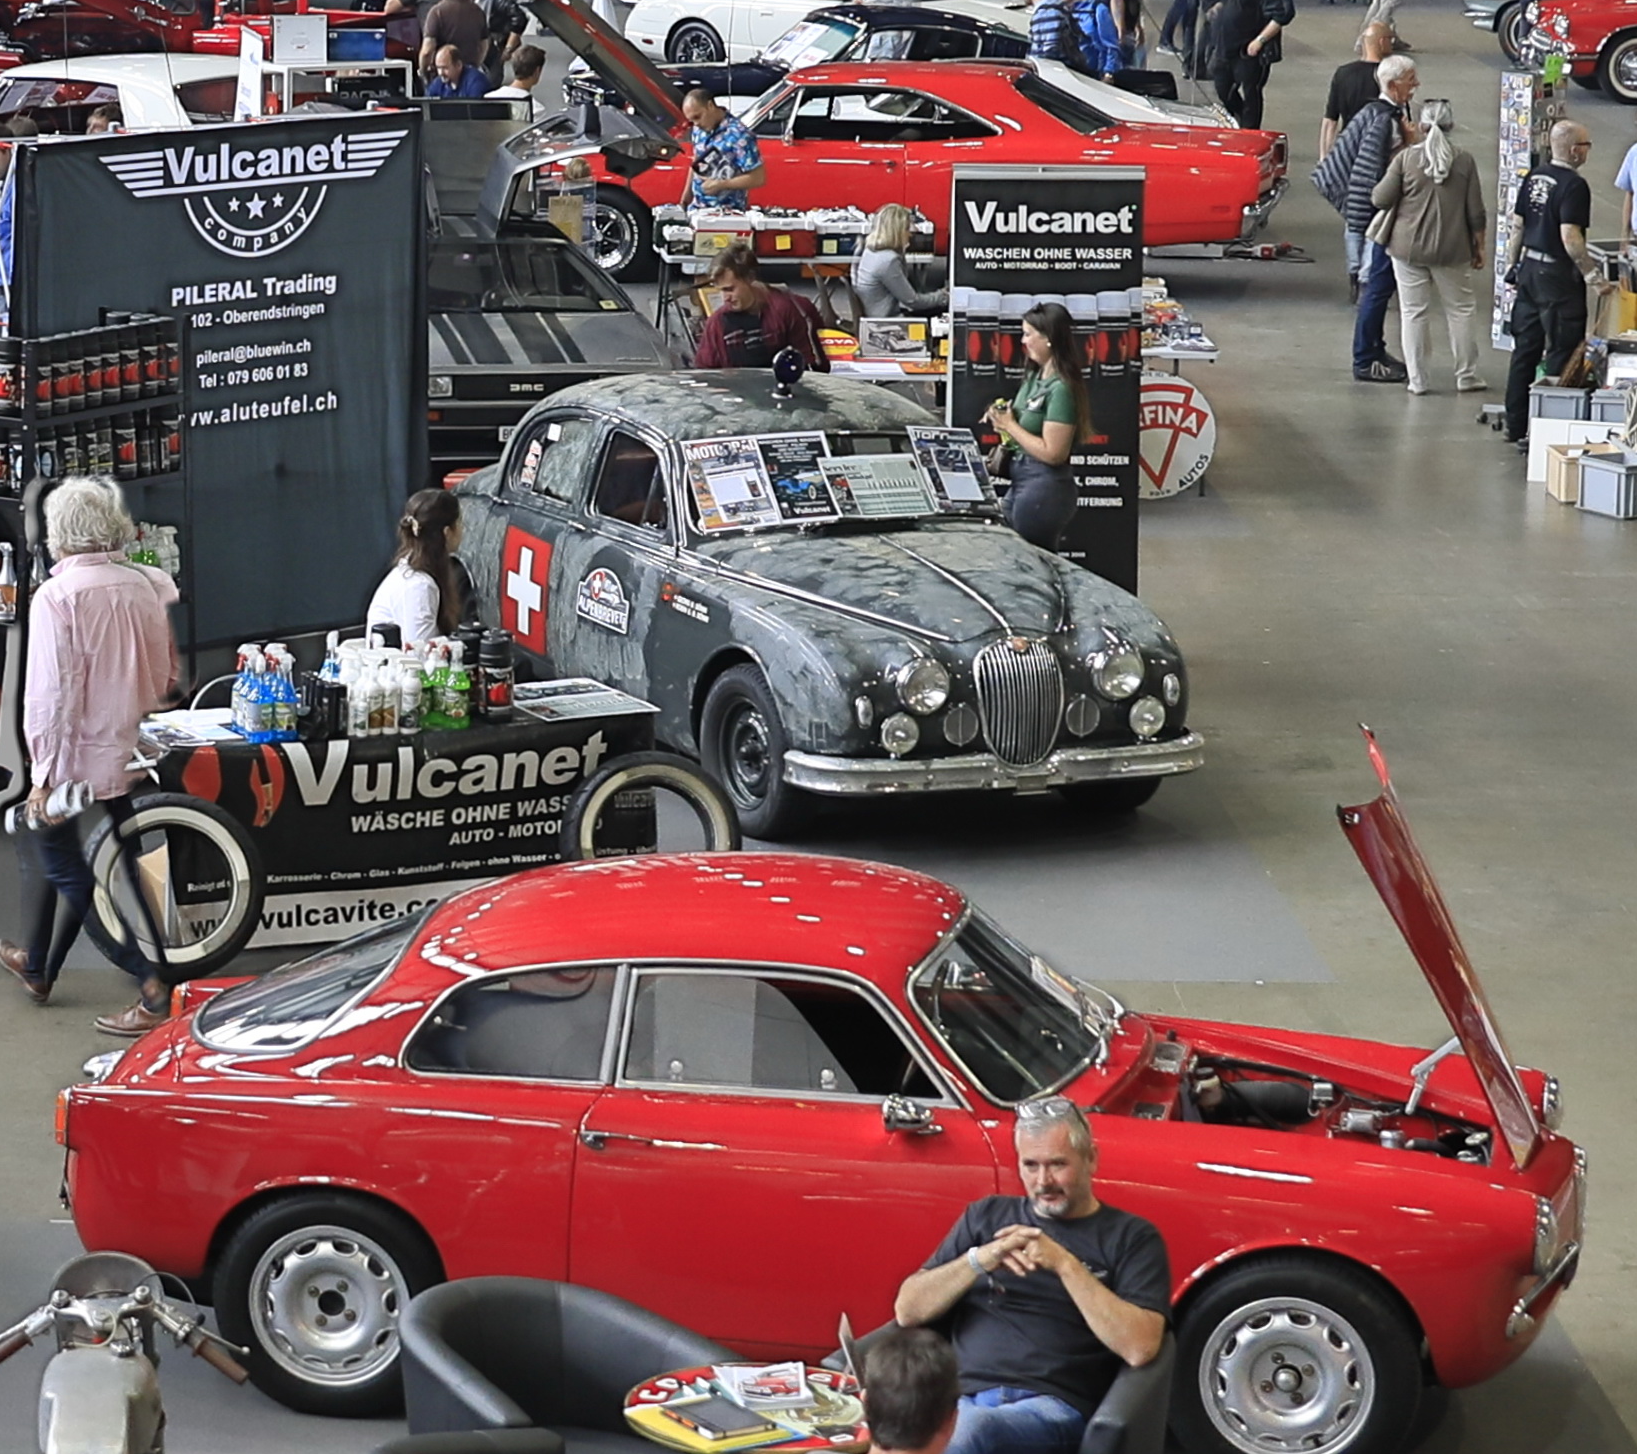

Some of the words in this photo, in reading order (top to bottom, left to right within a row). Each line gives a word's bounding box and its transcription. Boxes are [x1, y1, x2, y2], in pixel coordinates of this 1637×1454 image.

[163, 133, 347, 185] Vulcanet
[203, 205, 309, 252] company
[963, 201, 1134, 234] Vulcanet
[963, 248, 1030, 260] WASCHEN
[1034, 248, 1072, 260] OHNE
[1075, 248, 1133, 260] WASSER
[975, 261, 998, 270] AUTO
[1003, 261, 1049, 270] MOTORRAD
[1054, 261, 1078, 270] BOOT
[1083, 261, 1121, 270] CARAVAN
[171, 279, 258, 307] PILERAL
[263, 273, 338, 296] Trading
[196, 338, 311, 368] pileral@bluewin.ch
[199, 374, 217, 389] Tel
[227, 370, 249, 386] 079
[252, 367, 274, 383] 606
[276, 365, 292, 380] 01
[294, 362, 308, 379] 83
[1087, 453, 1130, 466] SCHÜTZEN
[1178, 452, 1210, 489] AUTOS
[1085, 476, 1120, 487] CHROM,
[280, 730, 608, 807] Vulcanet
[351, 809, 445, 833] WÄSCHE
[451, 801, 511, 825] OHNE
[448, 826, 495, 846] AUTO
[330, 869, 362, 881] Chrom
[369, 867, 391, 878] Glas
[397, 863, 445, 876] Kunststoff
[487, 854, 511, 866] ohne
[512, 852, 548, 864] Wasser
